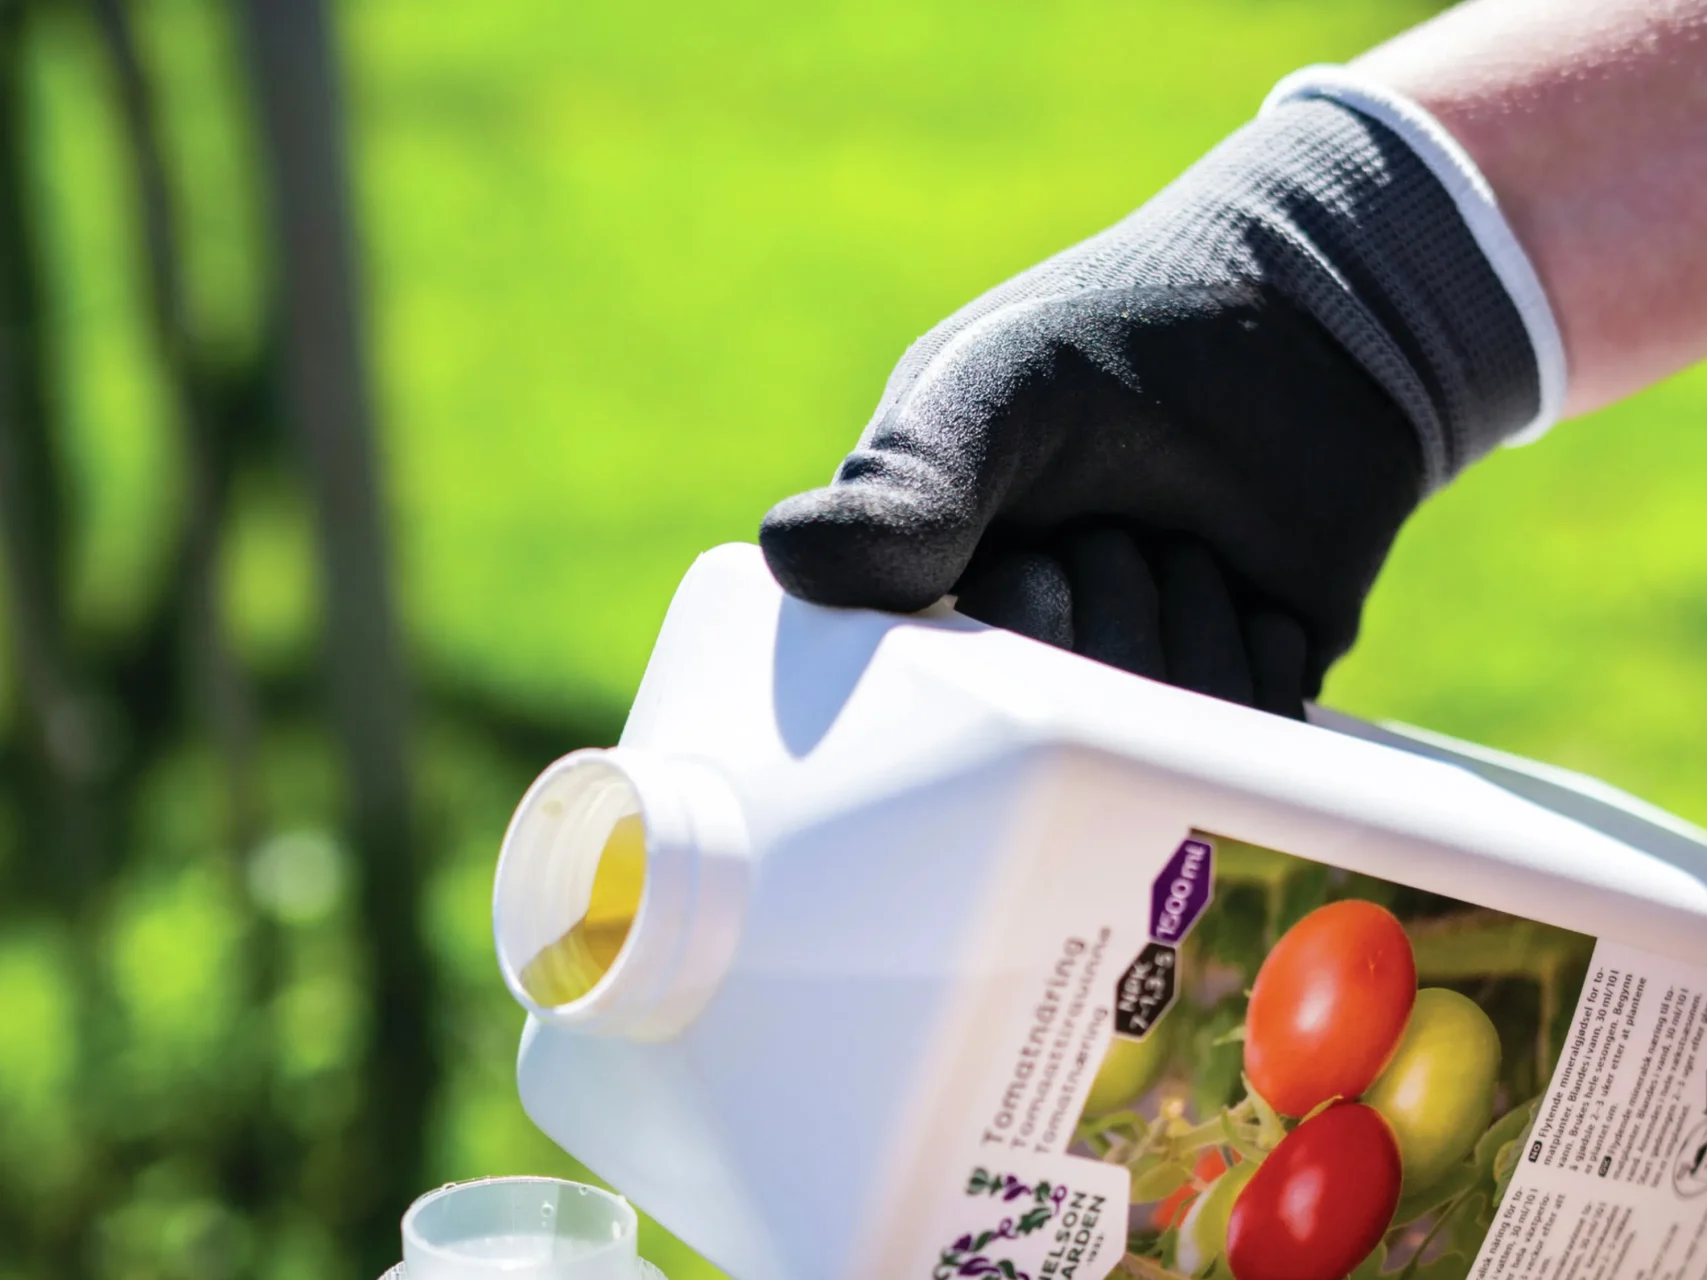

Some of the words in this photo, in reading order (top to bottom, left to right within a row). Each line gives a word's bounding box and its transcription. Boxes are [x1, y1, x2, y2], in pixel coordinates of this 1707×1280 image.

[981, 936, 1087, 1147] Tomatnäring
[1118, 961, 1152, 1013] NPK
[1567, 1061, 1590, 1102] Blandes
[1587, 1026, 1604, 1054] vann,
[1596, 1008, 1607, 1022] 30
[1602, 975, 1618, 1008] ml/10
[1601, 1072, 1614, 1097] uker
[1611, 1043, 1625, 1070] etter
[1622, 1028, 1630, 1040] at
[1626, 977, 1647, 1027] plantene
[1664, 986, 1674, 1002] to-
[1538, 1091, 1564, 1138] Flytende
[1560, 1006, 1593, 1088] mineralgjødsel
[1586, 986, 1599, 1003] for
[1593, 967, 1604, 983] to-
[1568, 1101, 1589, 1137] Brukes
[1583, 1075, 1599, 1099] hele
[1595, 1020, 1619, 1073] sesongen.
[1612, 974, 1633, 1016] Begynn
[1489, 1221, 1511, 1254] näring
[1511, 1187, 1523, 1201] to-
[1510, 1225, 1522, 1238] 30
